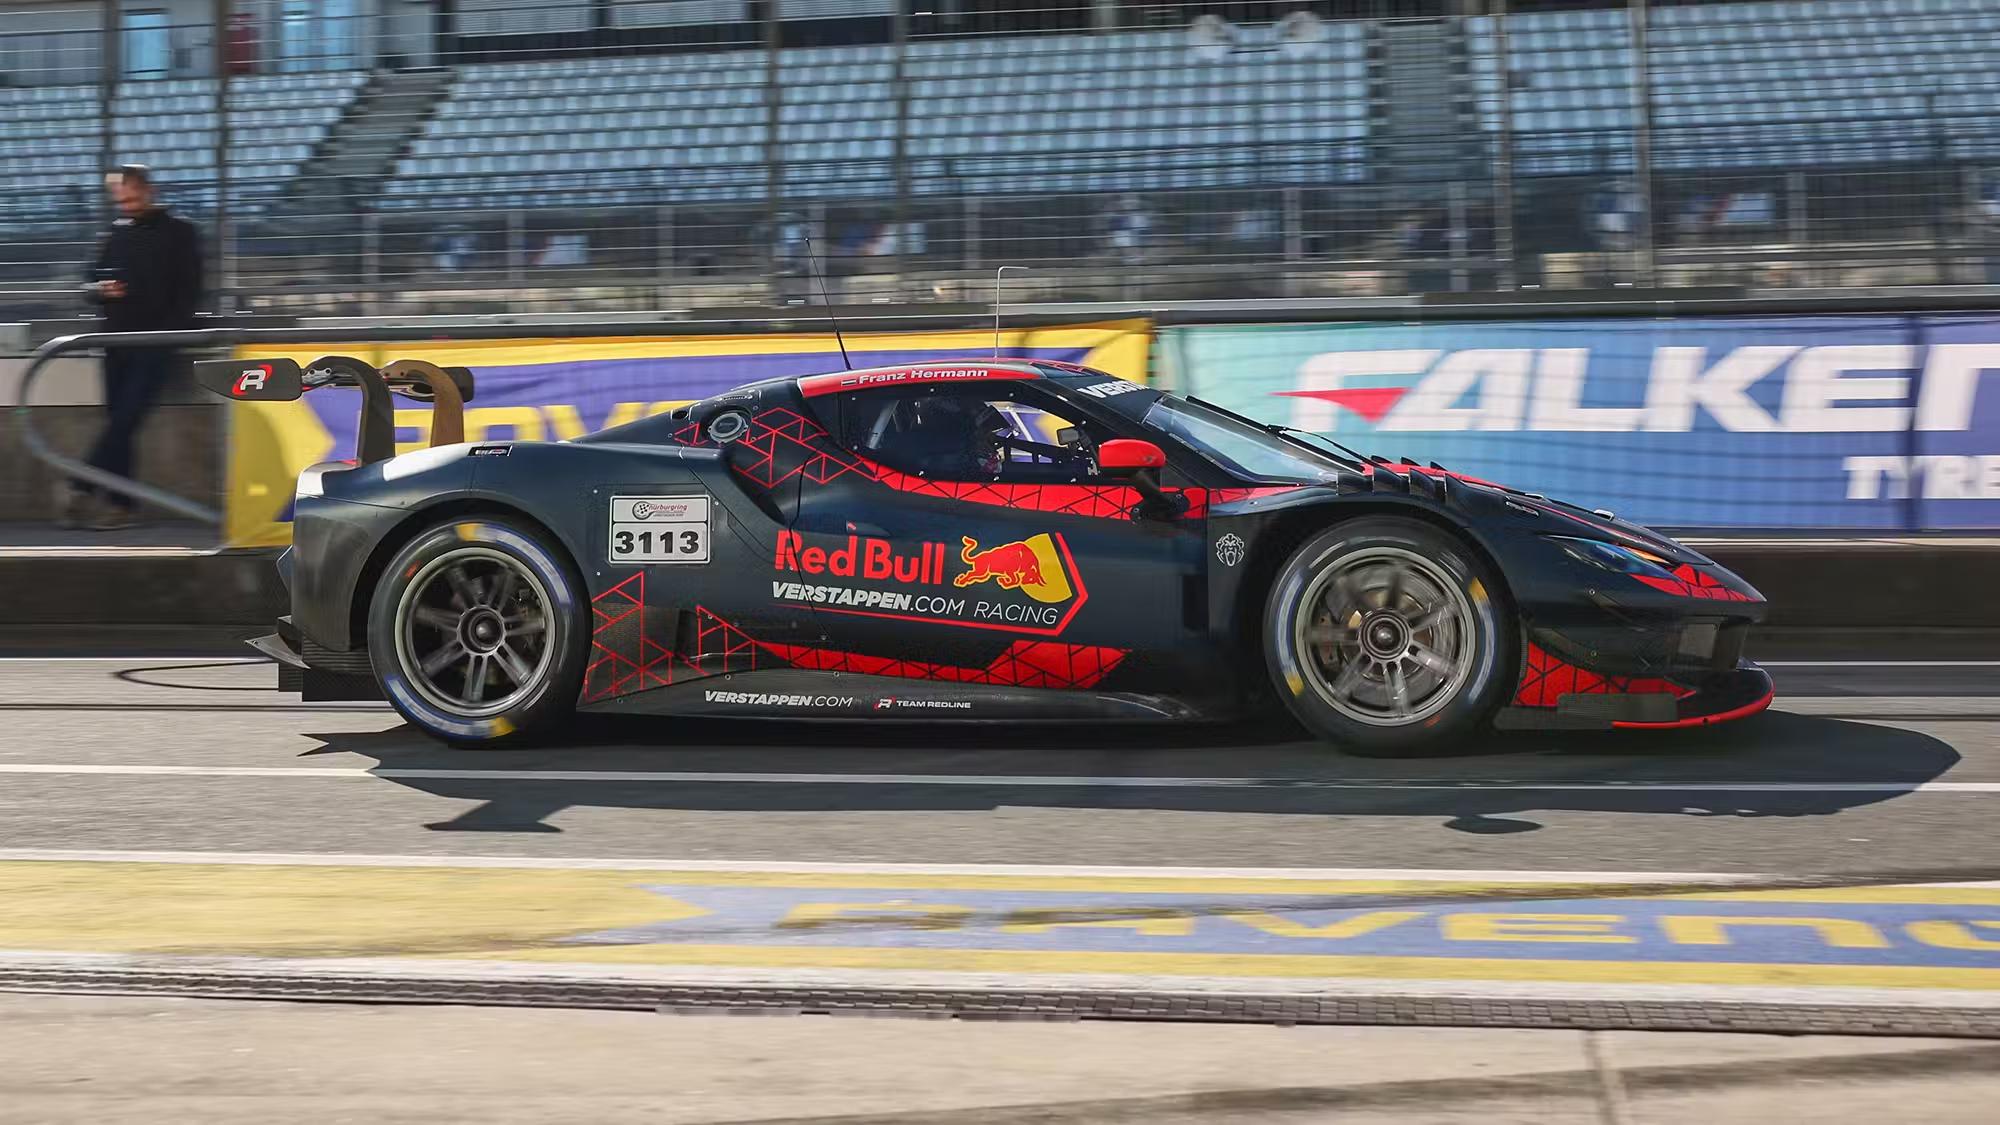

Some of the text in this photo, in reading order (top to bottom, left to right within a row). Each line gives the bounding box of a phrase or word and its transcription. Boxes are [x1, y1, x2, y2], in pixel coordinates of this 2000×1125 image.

[859, 369, 988, 384] Franz Hermann
[615, 531, 699, 554] 3113
[775, 529, 945, 585] Red Bull
[772, 581, 1059, 625] VERSTAPPEN.COM RACING
[704, 690, 853, 707] VERSTAPPEN.COM
[927, 701, 972, 709] REDLINE
